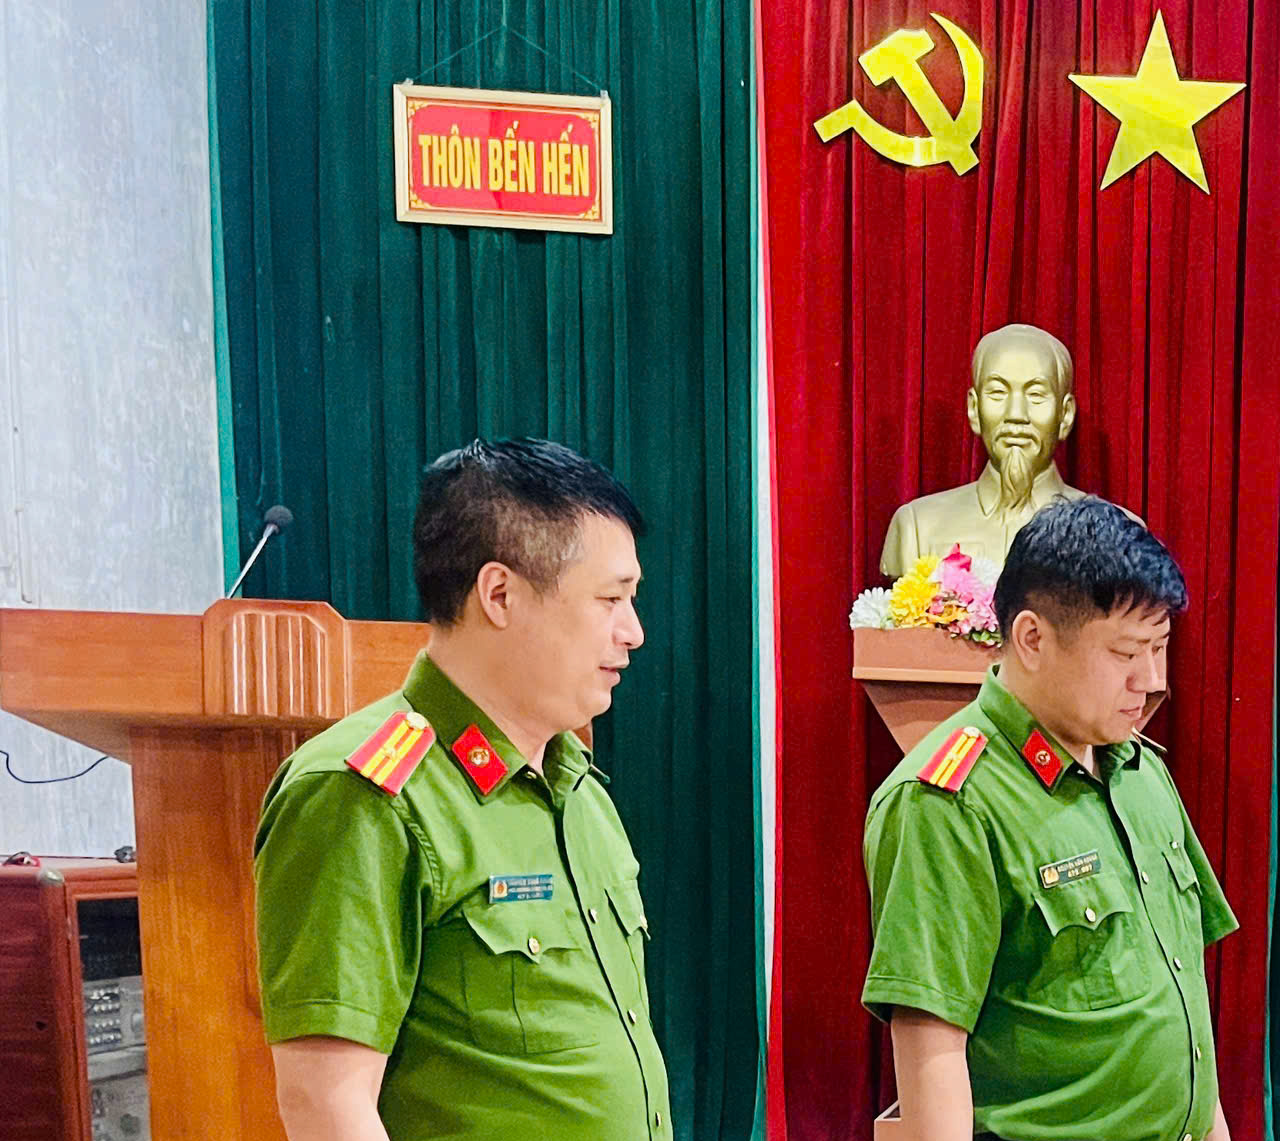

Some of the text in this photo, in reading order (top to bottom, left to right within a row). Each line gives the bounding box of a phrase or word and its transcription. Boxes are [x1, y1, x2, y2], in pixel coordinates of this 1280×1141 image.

[418, 120, 590, 197] THÔN BẾN HẾN
